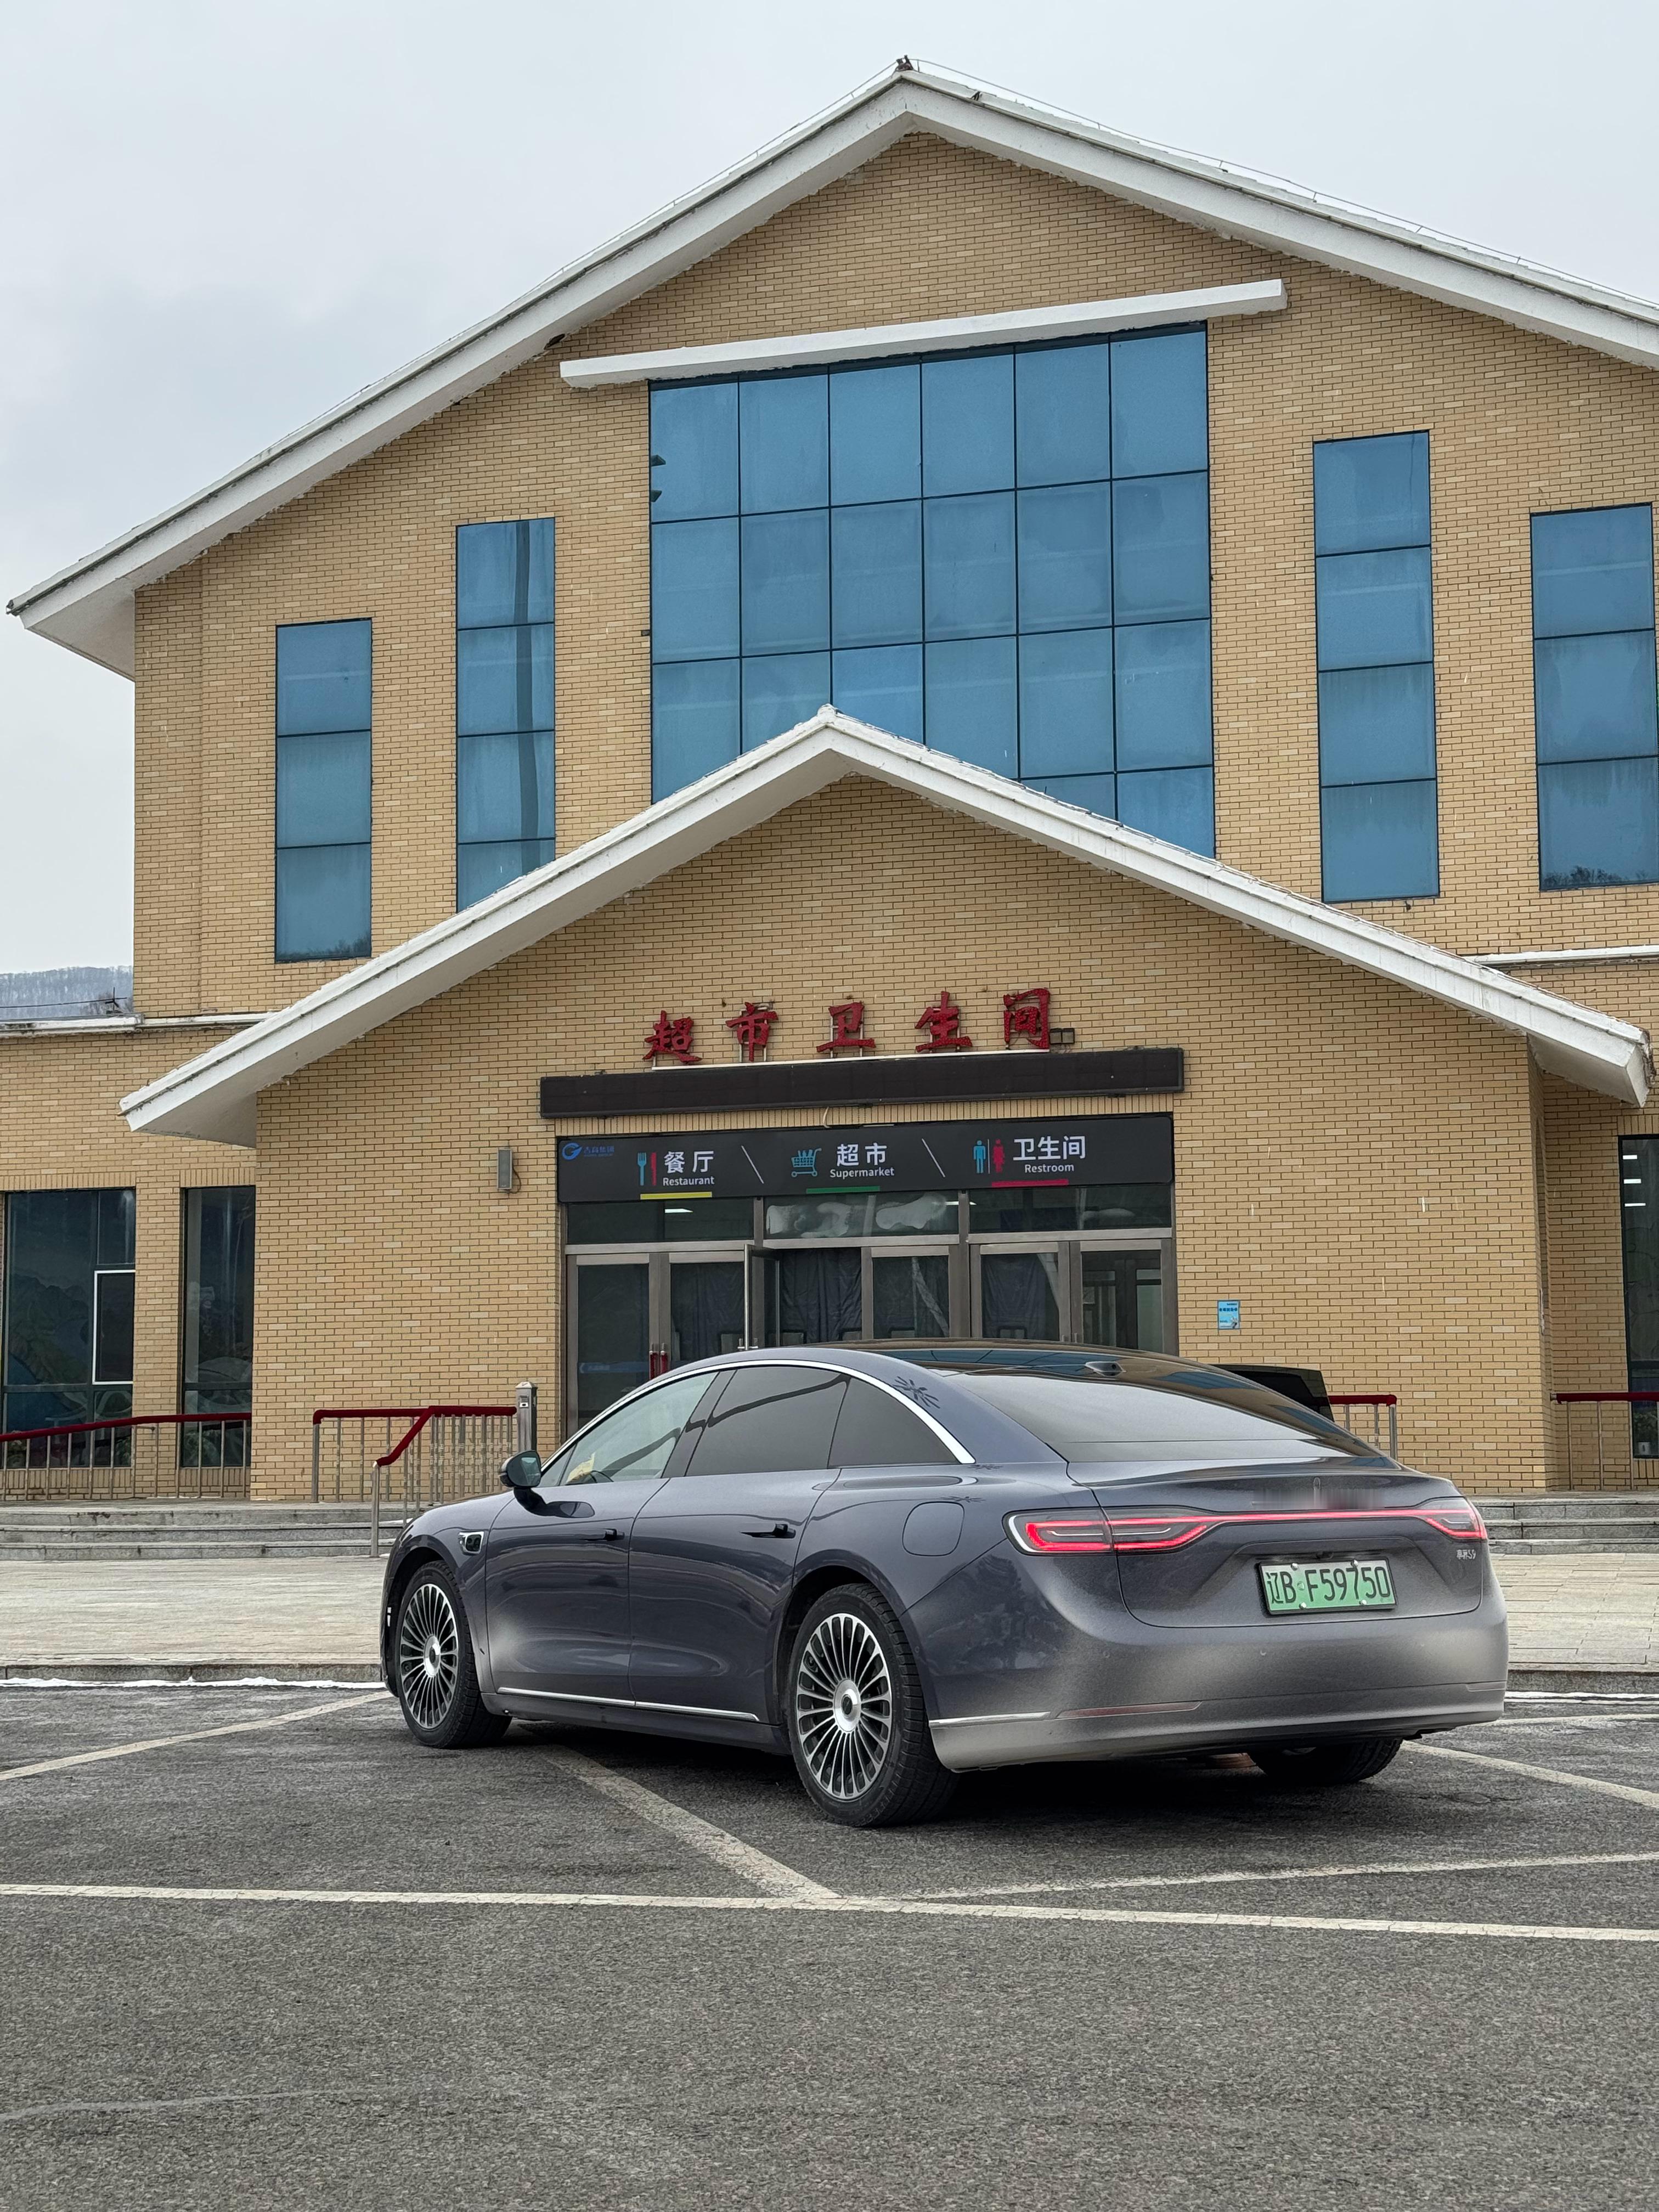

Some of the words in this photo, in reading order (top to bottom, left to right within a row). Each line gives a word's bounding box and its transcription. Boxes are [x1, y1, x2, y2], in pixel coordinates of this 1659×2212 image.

[643, 988, 1051, 1063] 超市卫生间
[836, 1142, 888, 1166] 超市
[1013, 1136, 1086, 1161] 卫生间
[663, 1150, 715, 1174] 餐厅
[830, 1166, 895, 1178] Supermarket
[1024, 1163, 1075, 1173] Restroom
[663, 1176, 715, 1187] Restaurant
